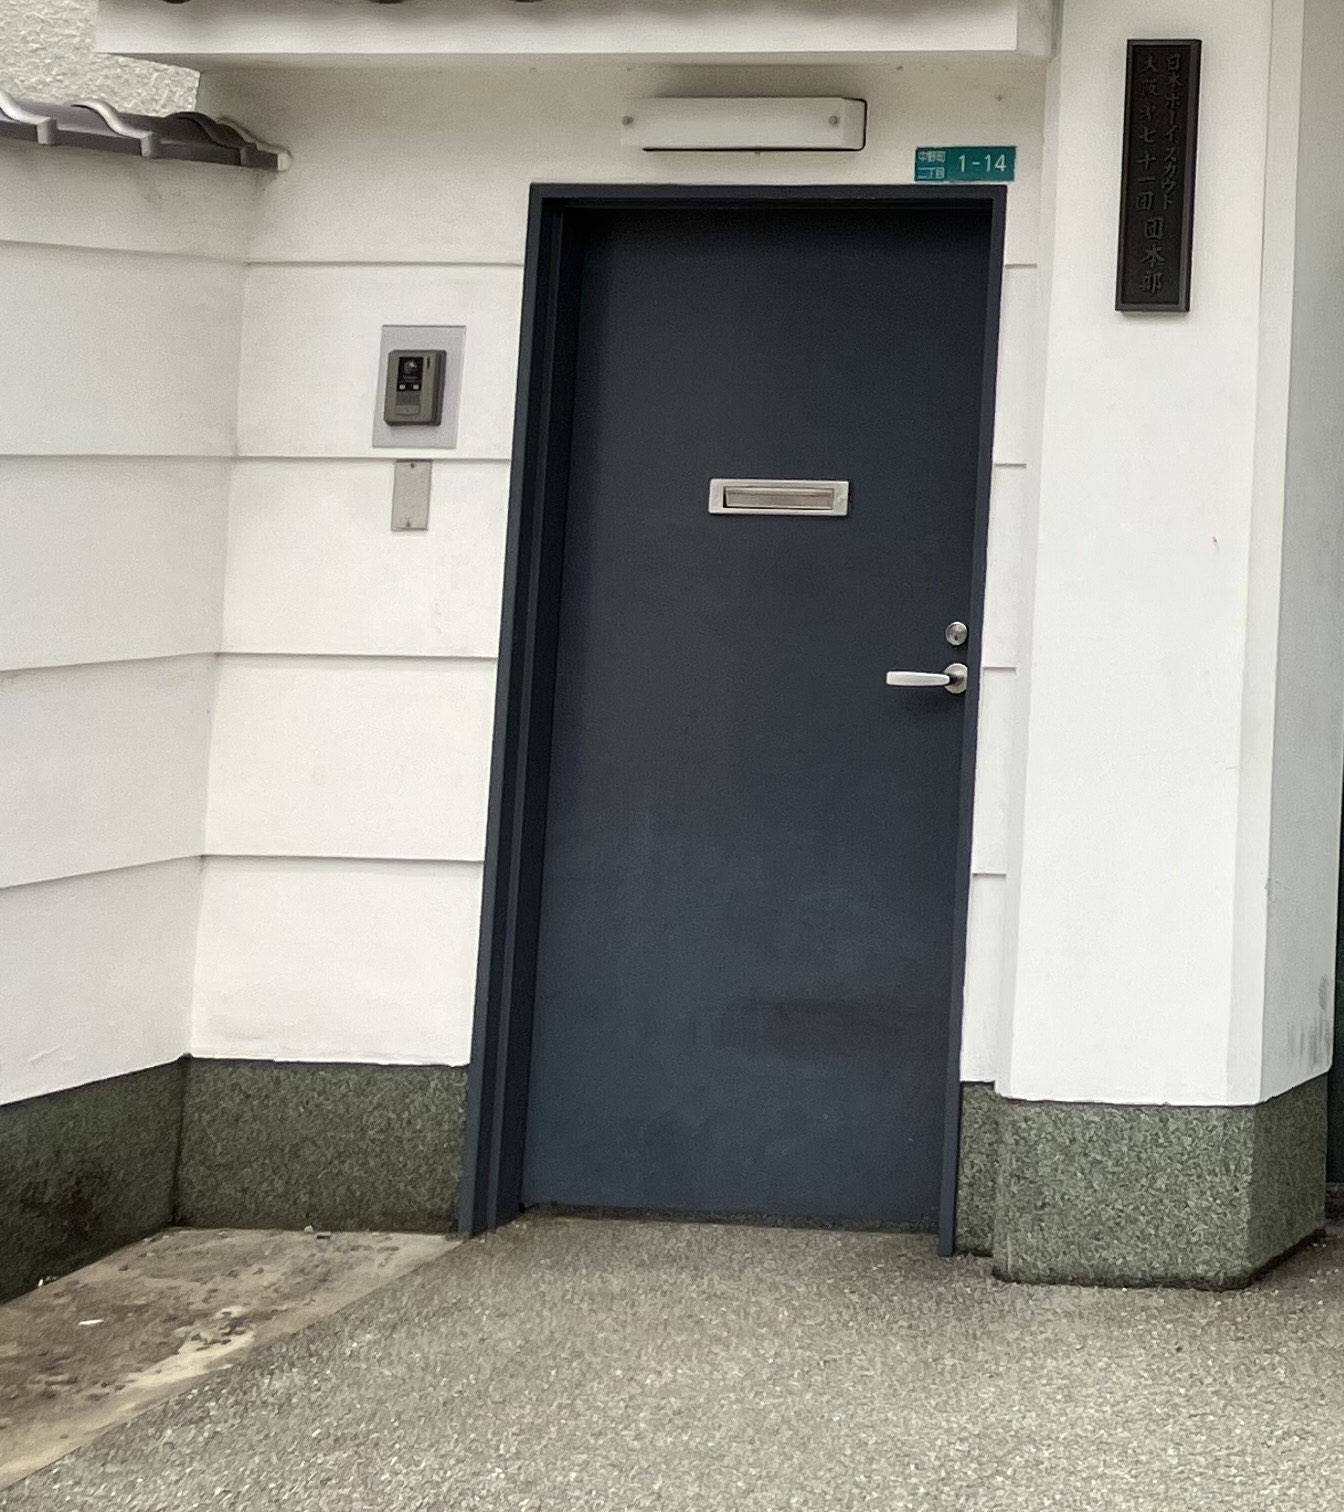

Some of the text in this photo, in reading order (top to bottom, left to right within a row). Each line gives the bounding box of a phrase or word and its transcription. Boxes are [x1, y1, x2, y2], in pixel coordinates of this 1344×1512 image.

[959, 153, 1007, 173] 1-14
[1160, 53, 1185, 210] 日本ボーイスカウト
